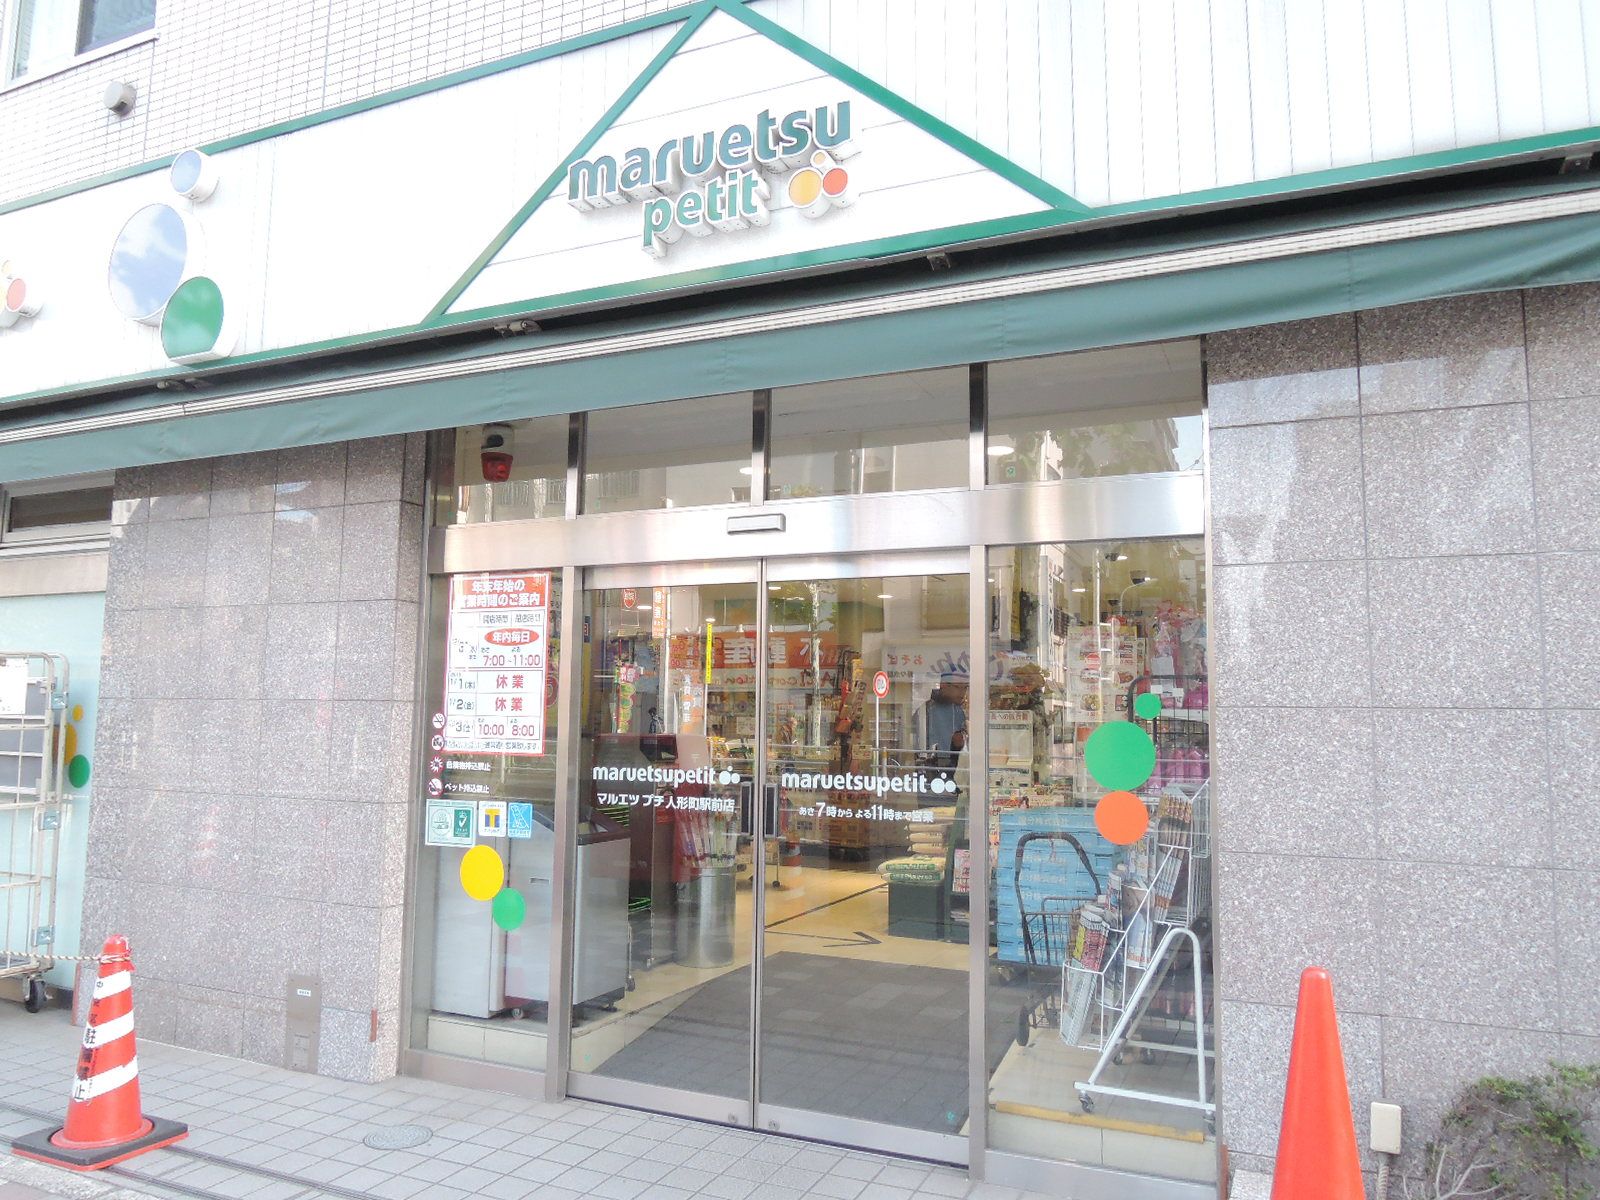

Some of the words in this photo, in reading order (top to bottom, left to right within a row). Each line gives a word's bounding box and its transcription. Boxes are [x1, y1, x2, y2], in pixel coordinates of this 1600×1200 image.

[568, 100, 851, 200] maruetsu
[643, 171, 759, 247] petit
[492, 631, 531, 643] 年内毎日
[592, 765, 717, 789] maruetsupetit
[781, 771, 928, 797] maruetsupetit
[596, 793, 640, 806] マルエツ
[642, 794, 665, 807] プチ
[665, 795, 736, 812] 人形町駅前店
[799, 802, 853, 818] あさ7時から
[855, 804, 934, 823] よる11時まで営業
